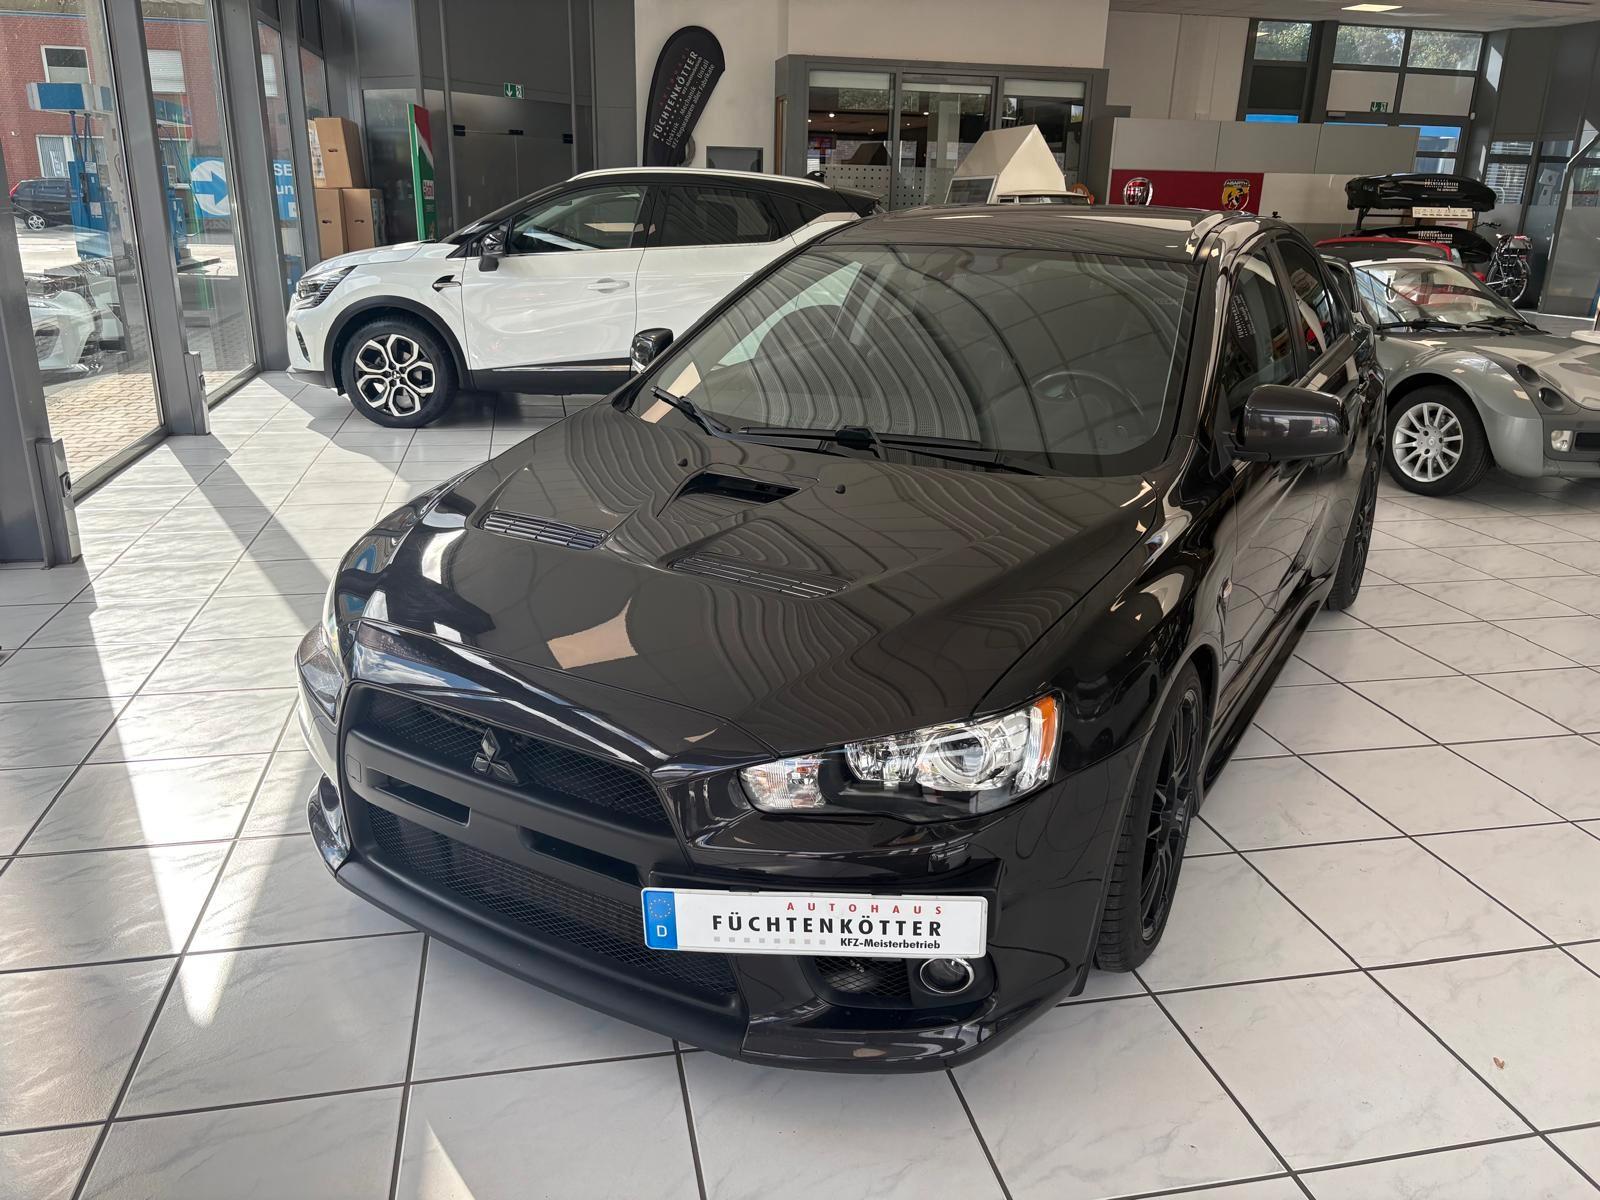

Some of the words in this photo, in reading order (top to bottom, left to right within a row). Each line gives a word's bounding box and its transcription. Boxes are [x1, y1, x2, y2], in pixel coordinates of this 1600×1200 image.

[652, 50, 699, 140] FÜCHTENKÖTTER
[664, 121, 680, 147] Elektrik
[679, 85, 697, 116] Mechanik
[786, 902, 943, 915] AUTOHAUS
[656, 924, 668, 938] D
[712, 910, 943, 937] FÜCHTENKÖTTER
[839, 937, 942, 950] KFZ-Meisterbetrieb
